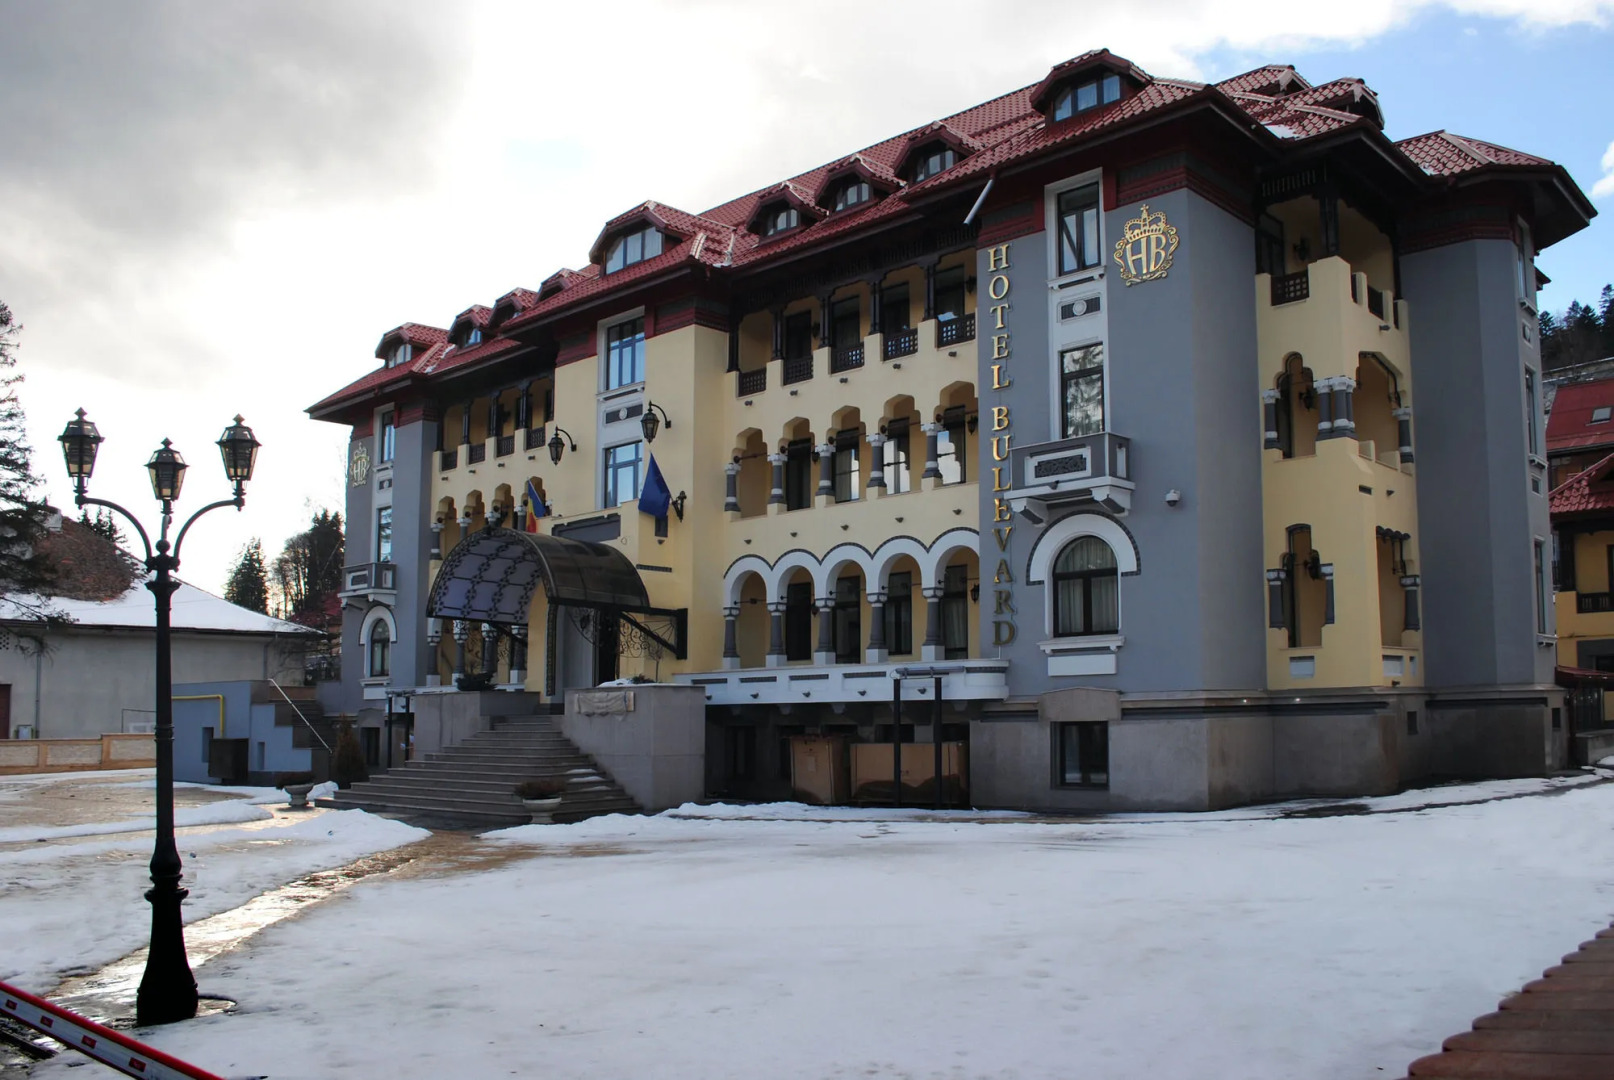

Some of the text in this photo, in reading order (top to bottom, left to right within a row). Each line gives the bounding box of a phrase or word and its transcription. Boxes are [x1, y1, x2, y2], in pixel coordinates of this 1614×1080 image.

[1126, 233, 1167, 275] HB
[987, 243, 1016, 646] HOTEL BULEVARD
[353, 458, 367, 481] HB
